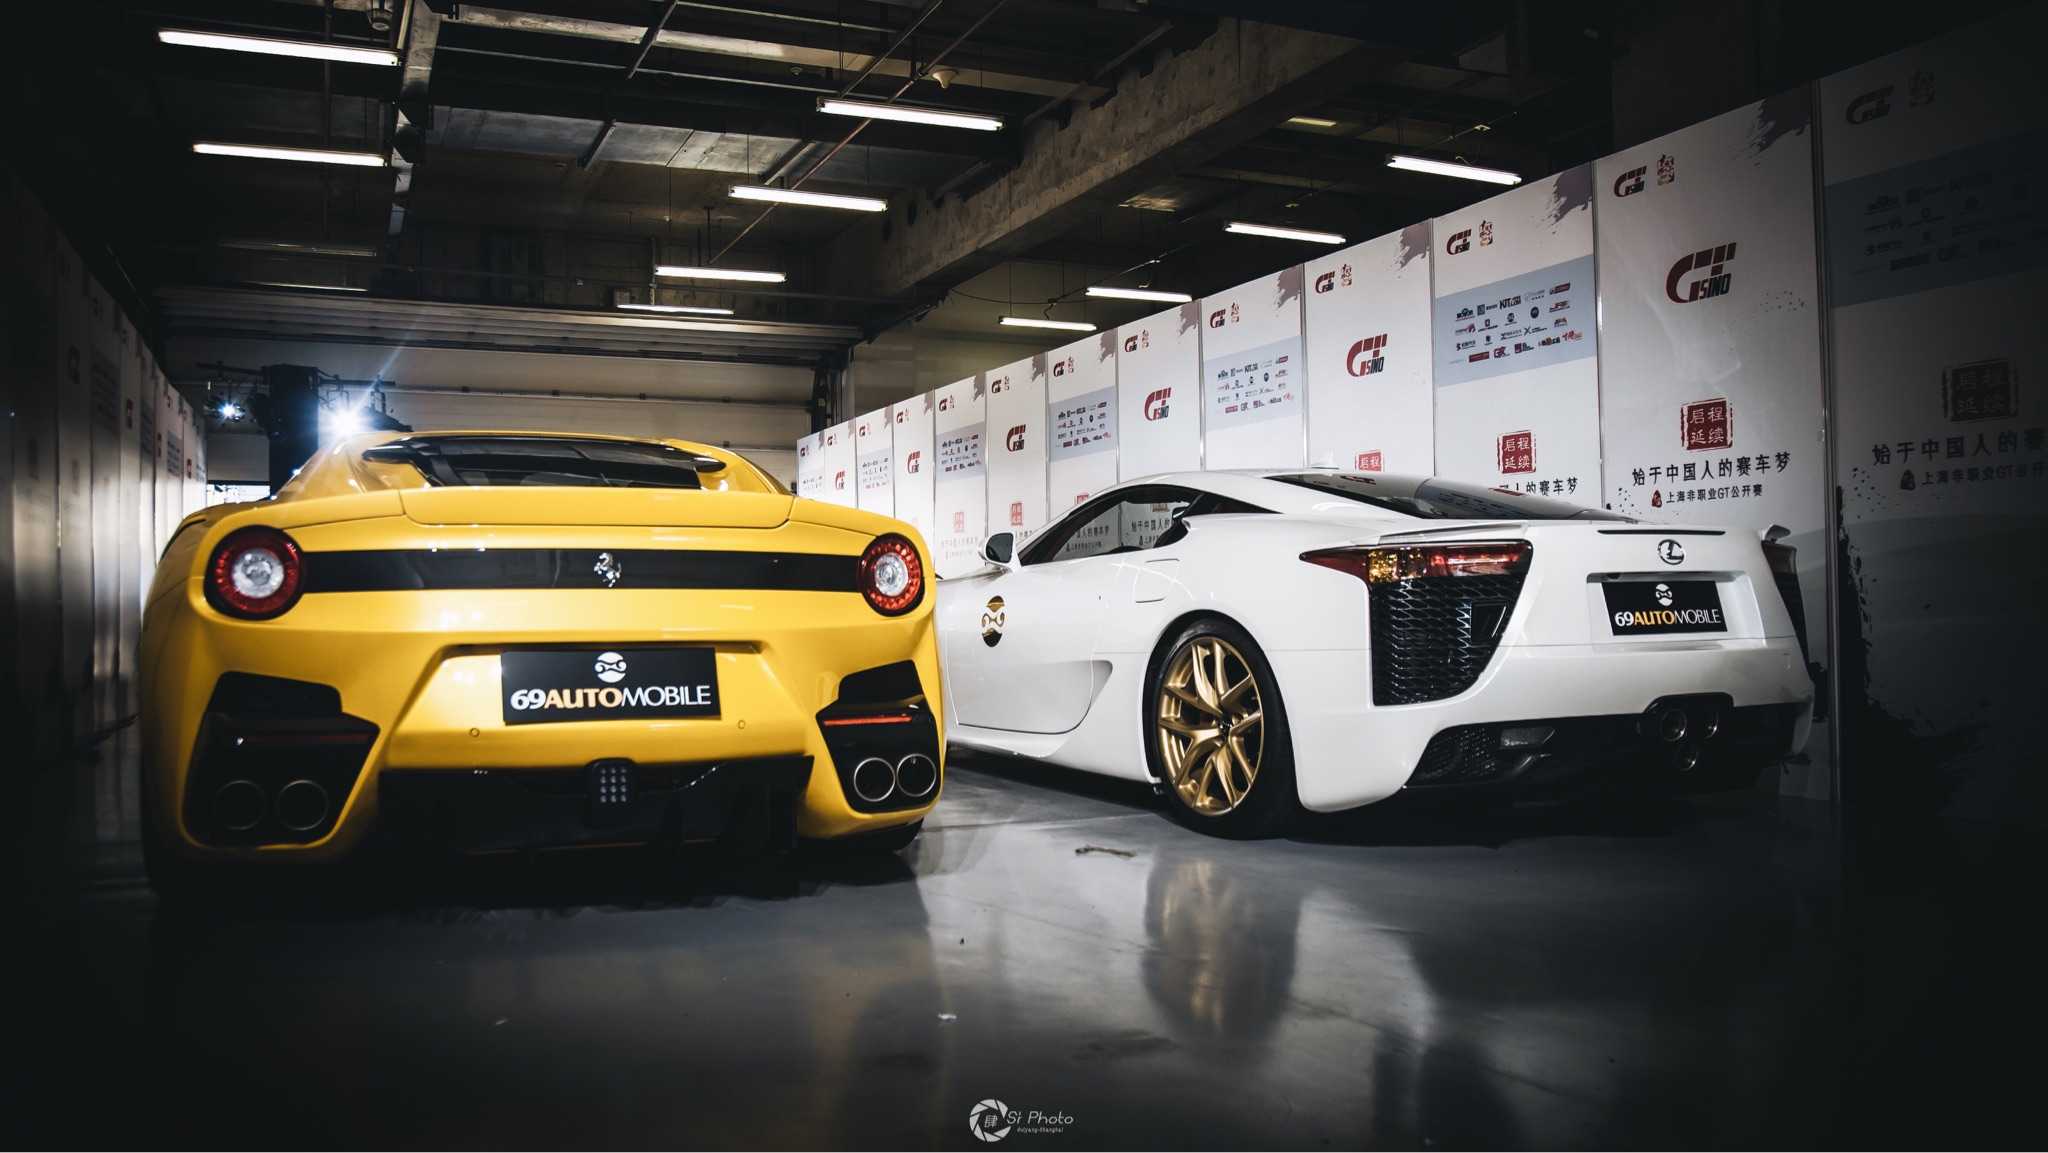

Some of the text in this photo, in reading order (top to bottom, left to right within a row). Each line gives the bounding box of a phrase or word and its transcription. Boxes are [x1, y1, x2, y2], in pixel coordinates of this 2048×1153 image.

[1631, 450, 1791, 487] 始于中国人的赛车梦
[1614, 609, 1720, 627] 69AUTOMOBILE
[510, 685, 711, 711] 69AUTOMOBILE
